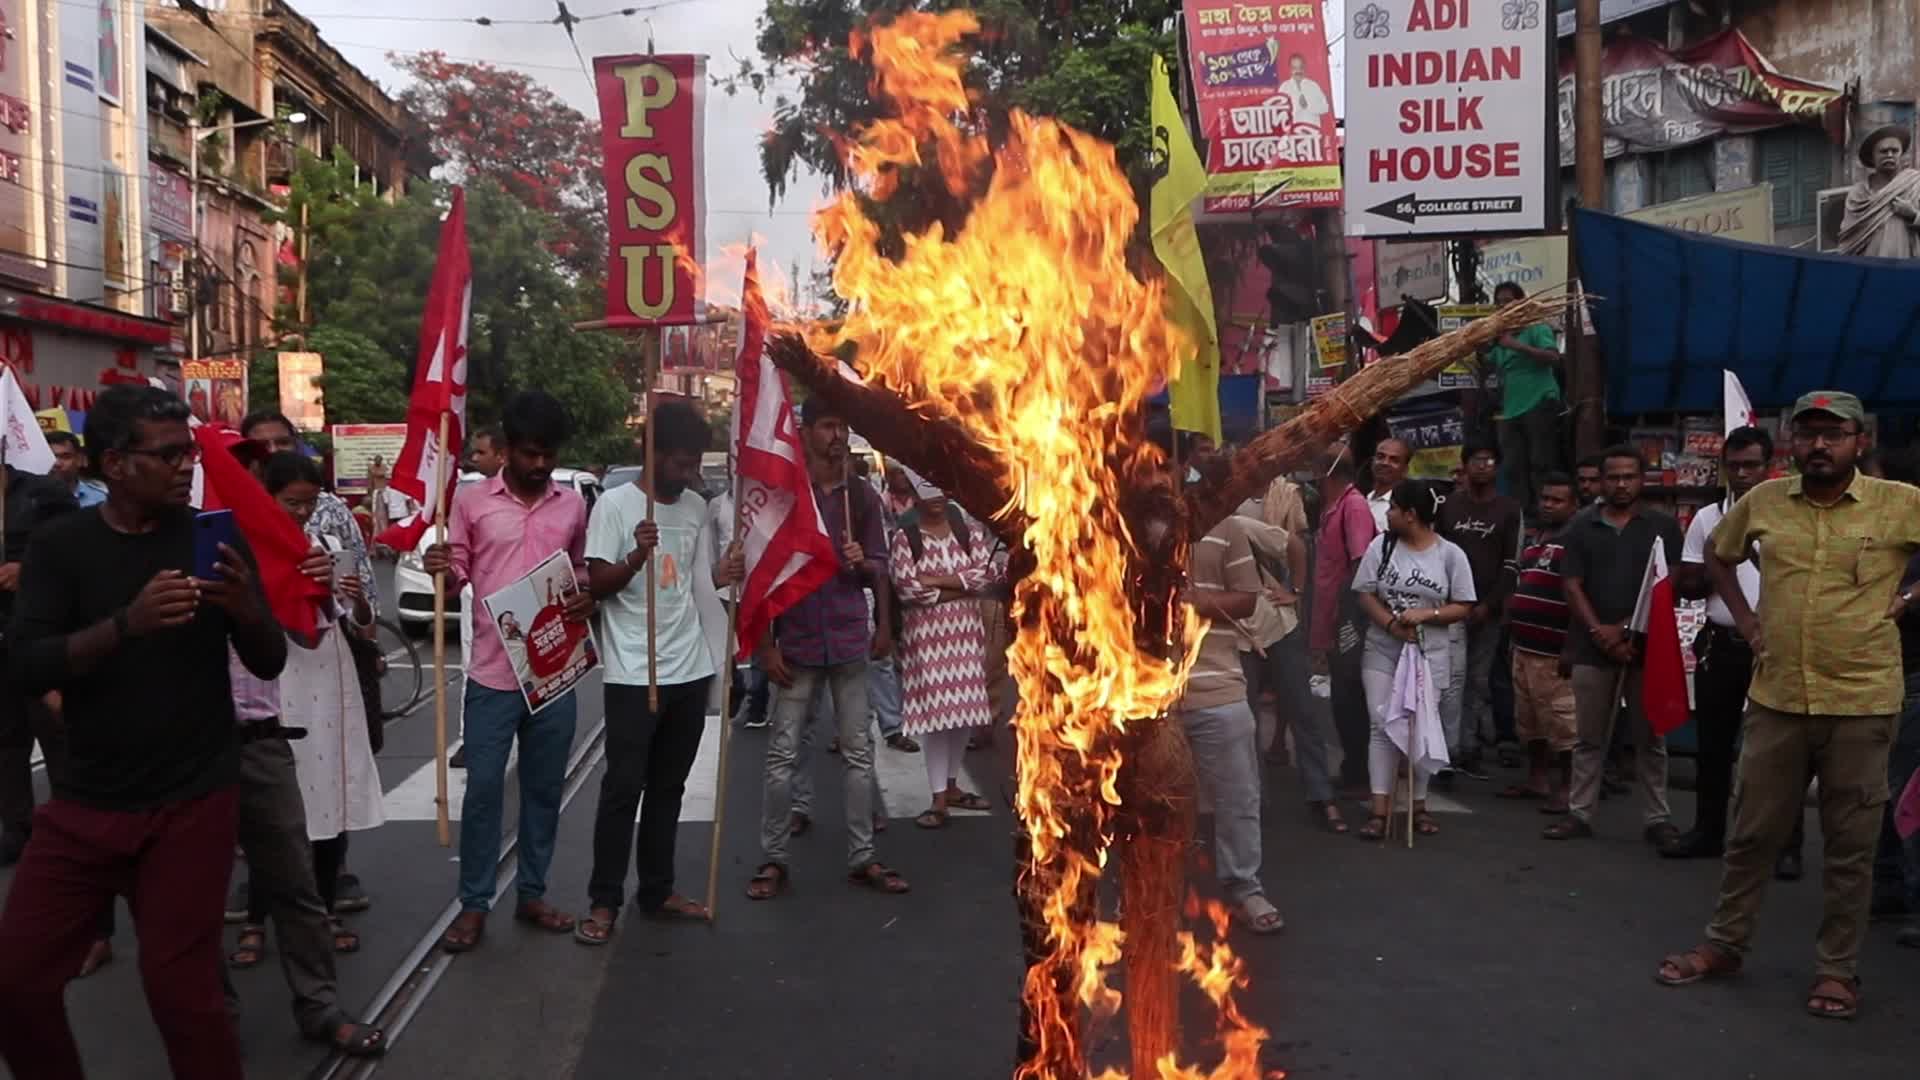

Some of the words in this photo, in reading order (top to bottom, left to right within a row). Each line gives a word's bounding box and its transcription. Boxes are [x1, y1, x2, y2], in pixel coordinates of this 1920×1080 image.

[1406, 0, 1469, 32] ADI
[1368, 46, 1520, 88] INDIAN
[1230, 95, 1291, 134] আদি
[1399, 96, 1484, 134] SILK
[1222, 124, 1322, 167] ঢাকেশ্বরী
[1369, 143, 1520, 182] HOUSE
[613, 63, 679, 320] PSU
[1418, 201, 1469, 213] COLLEGE
[1472, 200, 1515, 211] STREET
